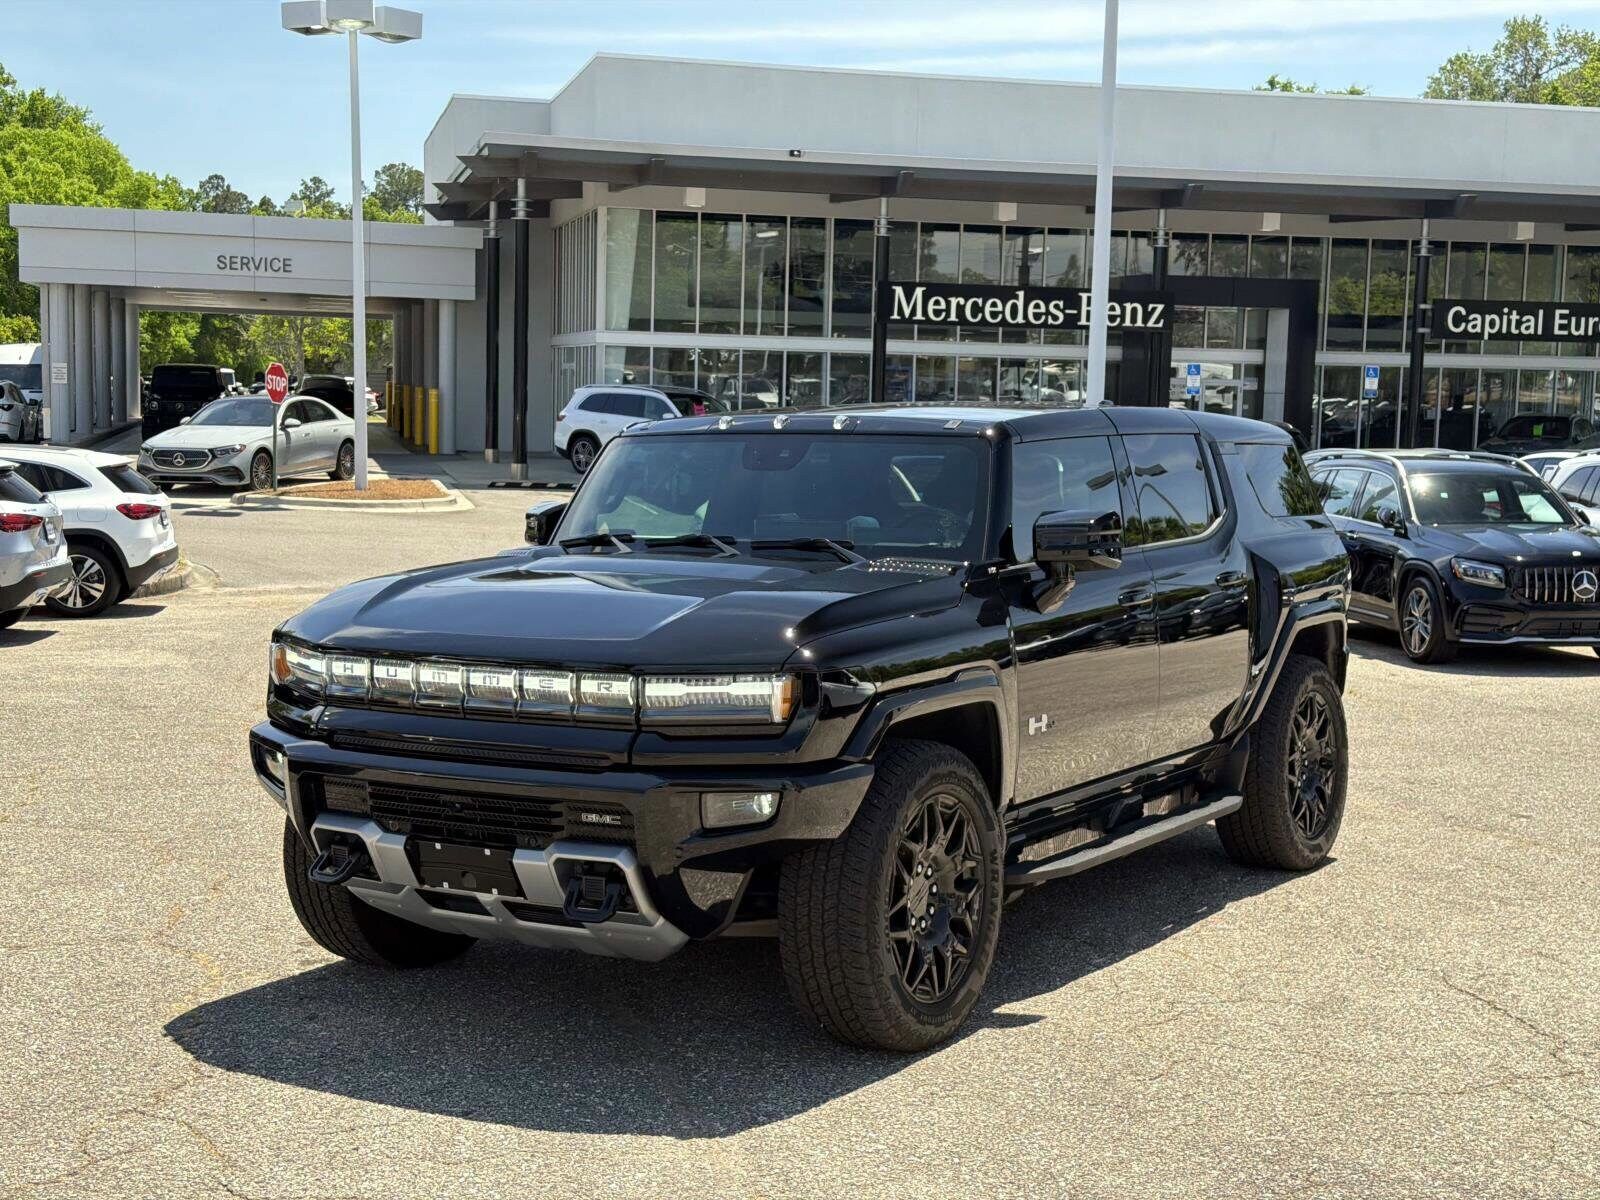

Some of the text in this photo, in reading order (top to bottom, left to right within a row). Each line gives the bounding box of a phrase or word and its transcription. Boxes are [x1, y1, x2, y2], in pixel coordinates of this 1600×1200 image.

[216, 254, 293, 273] SERVICE
[1447, 305, 1600, 340] Capital Eur
[267, 374, 287, 392] STOP
[581, 812, 621, 825] GMC
